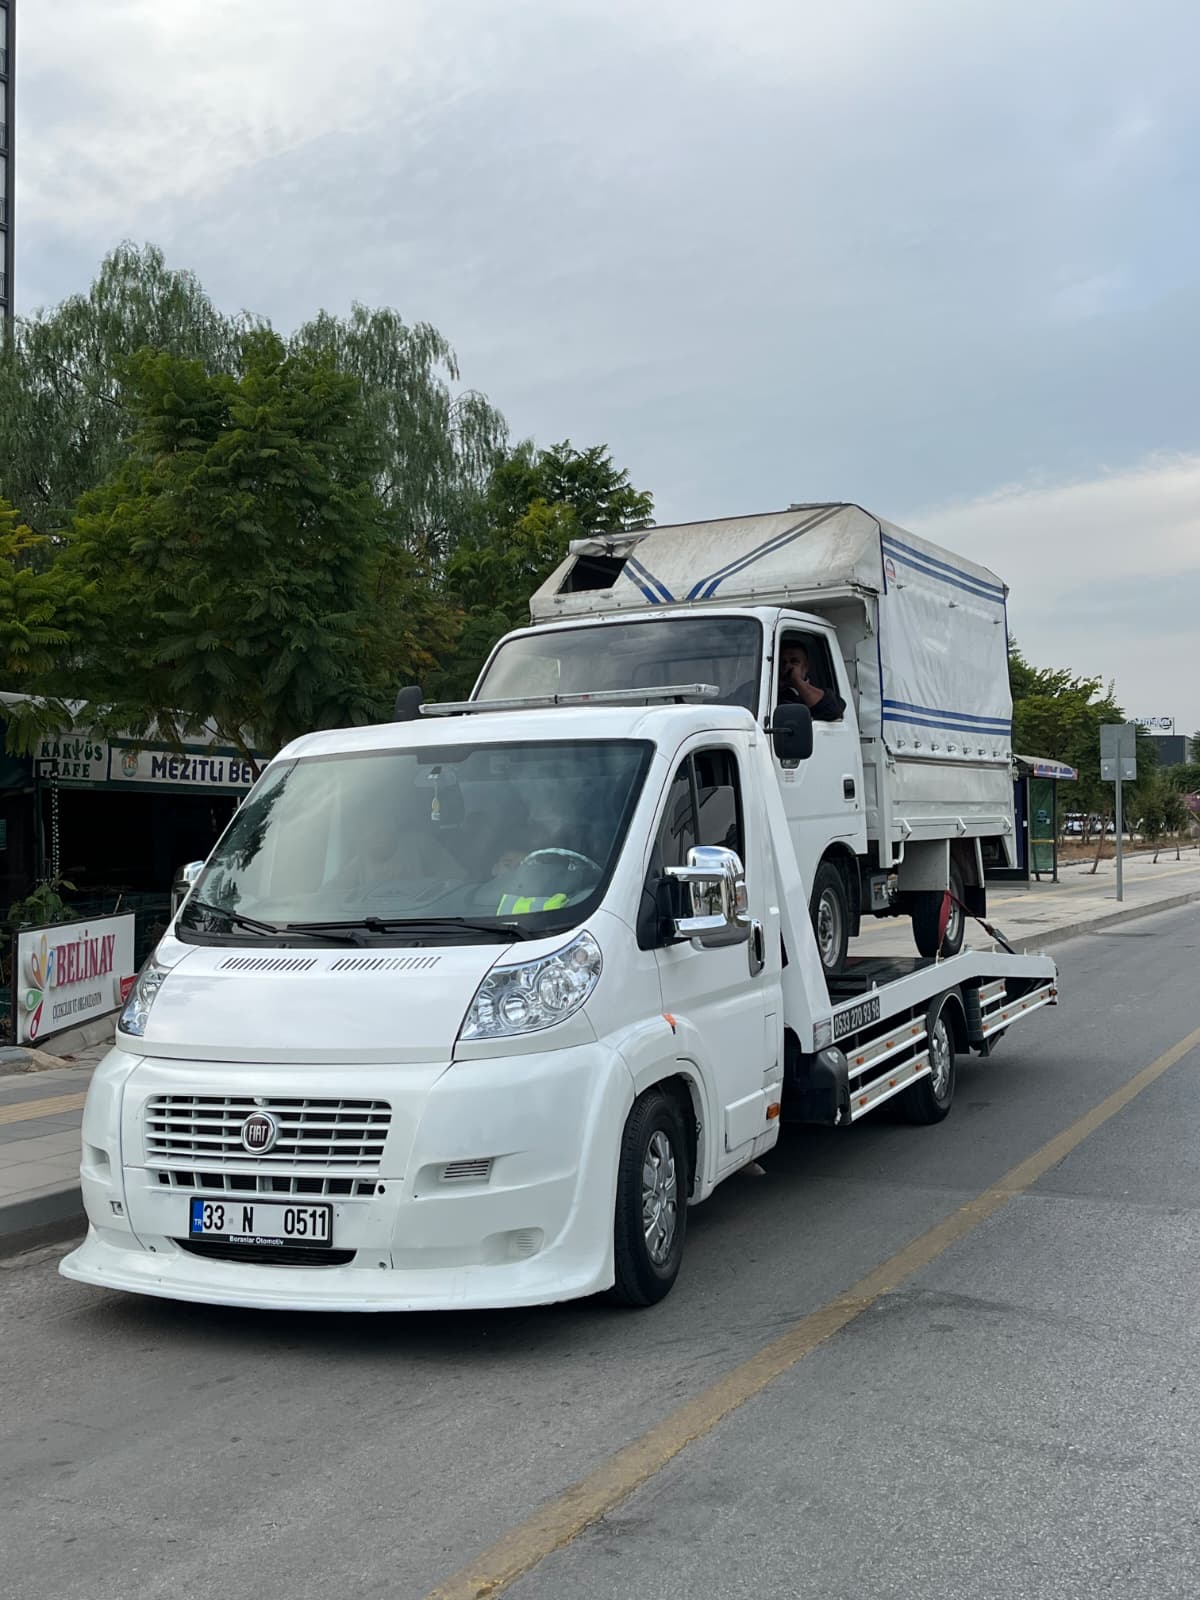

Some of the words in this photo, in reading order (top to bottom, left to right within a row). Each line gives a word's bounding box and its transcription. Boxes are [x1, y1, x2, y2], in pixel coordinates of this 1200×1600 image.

[151, 756, 223, 782] MEZİTLİ
[56, 929, 115, 987] BELİNAY
[834, 1012, 850, 1035] 0533
[851, 1007, 863, 1028] 270
[249, 1125, 267, 1142] FIAT
[203, 1204, 225, 1230] 33
[242, 1206, 253, 1232] N
[284, 1208, 326, 1236] 0511
[255, 1236, 284, 1245] Otomotiv
